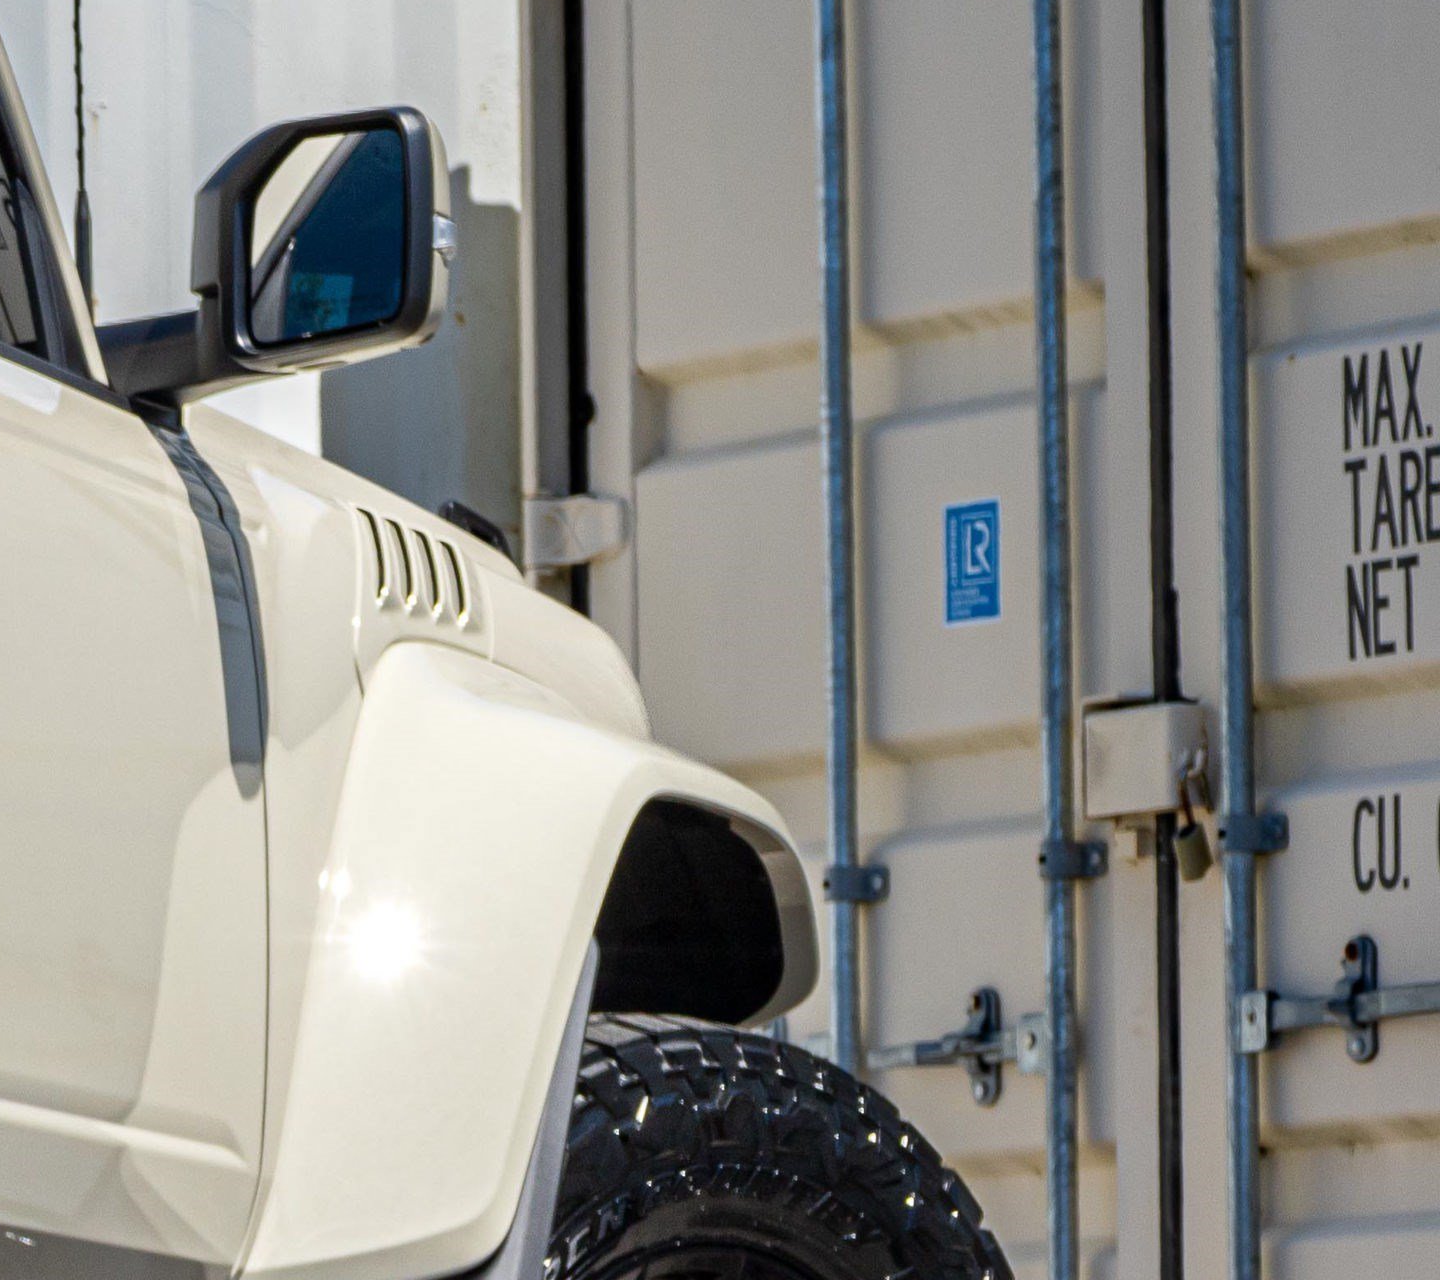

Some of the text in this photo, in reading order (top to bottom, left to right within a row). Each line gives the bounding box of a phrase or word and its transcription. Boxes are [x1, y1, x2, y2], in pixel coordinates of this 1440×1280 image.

[1342, 342, 1433, 451] MAX.
[1343, 442, 1440, 556] TARE
[1346, 554, 1421, 661] NET
[1352, 794, 1410, 894] CU.
